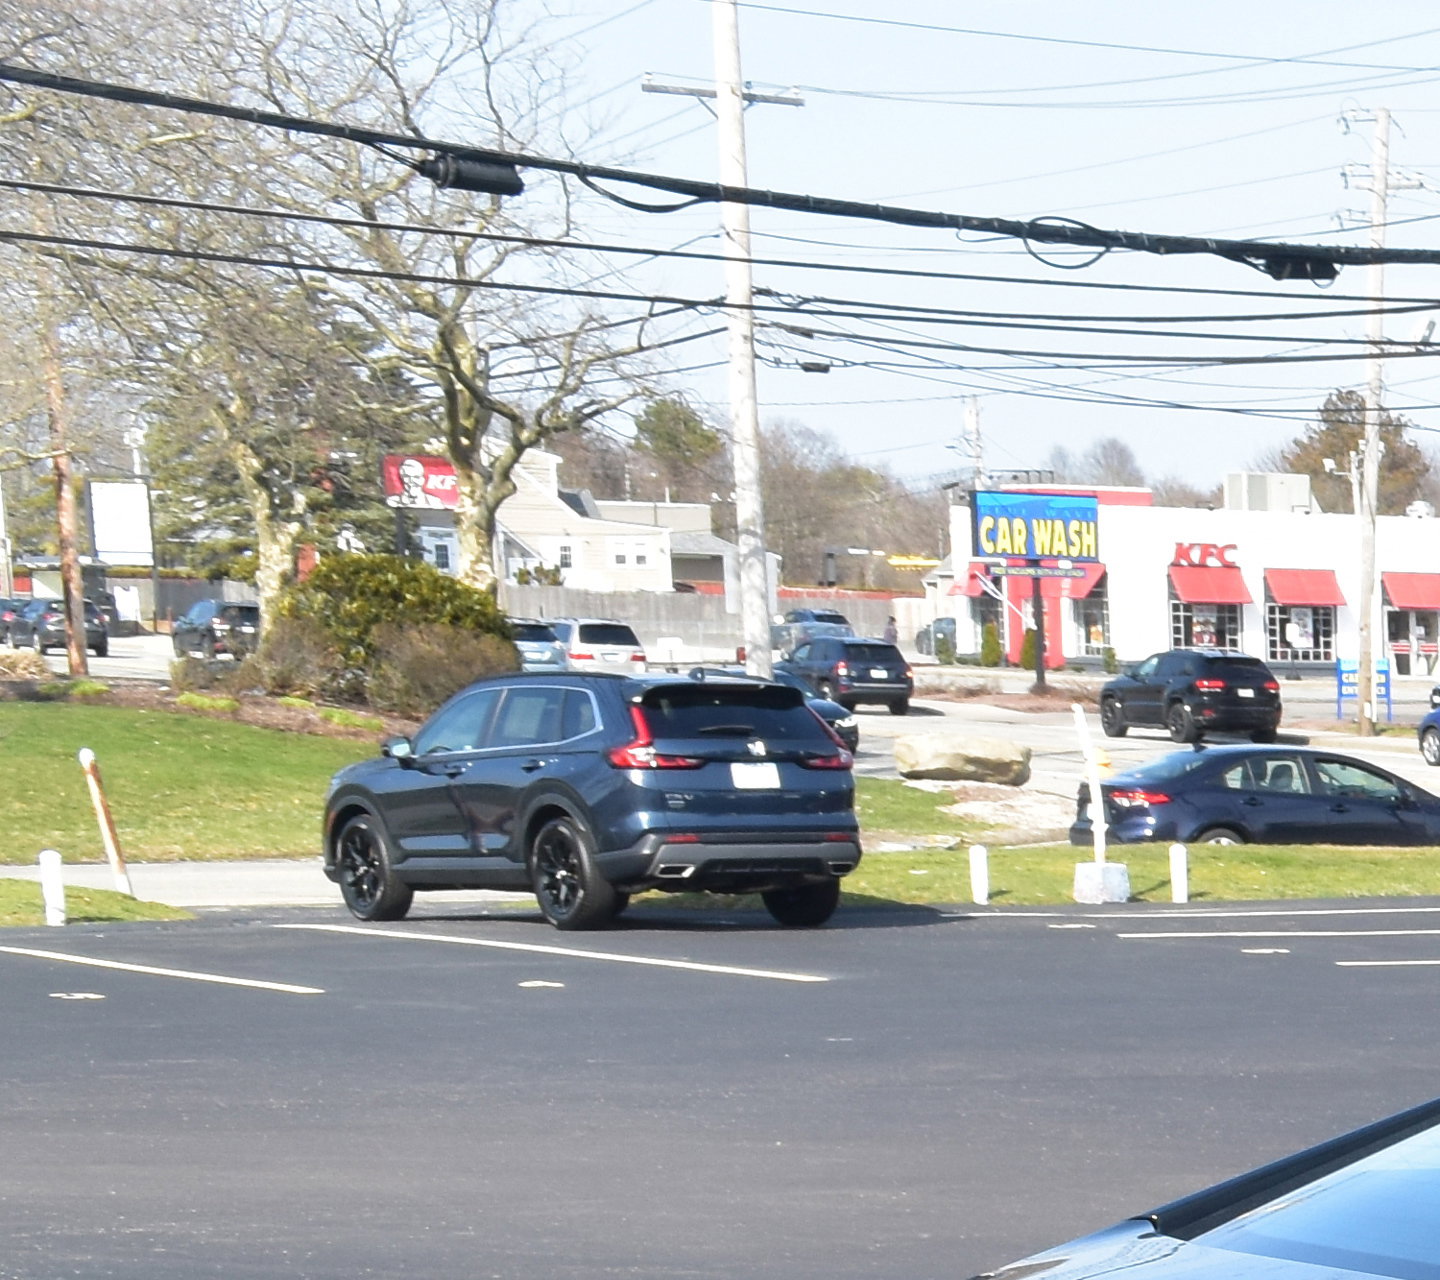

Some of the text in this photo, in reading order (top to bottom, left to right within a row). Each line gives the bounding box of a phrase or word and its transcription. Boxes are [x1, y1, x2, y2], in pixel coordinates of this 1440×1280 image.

[426, 474, 458, 490] KF
[980, 515, 1097, 558] CAR WASH
[1169, 542, 1238, 567] KFC
